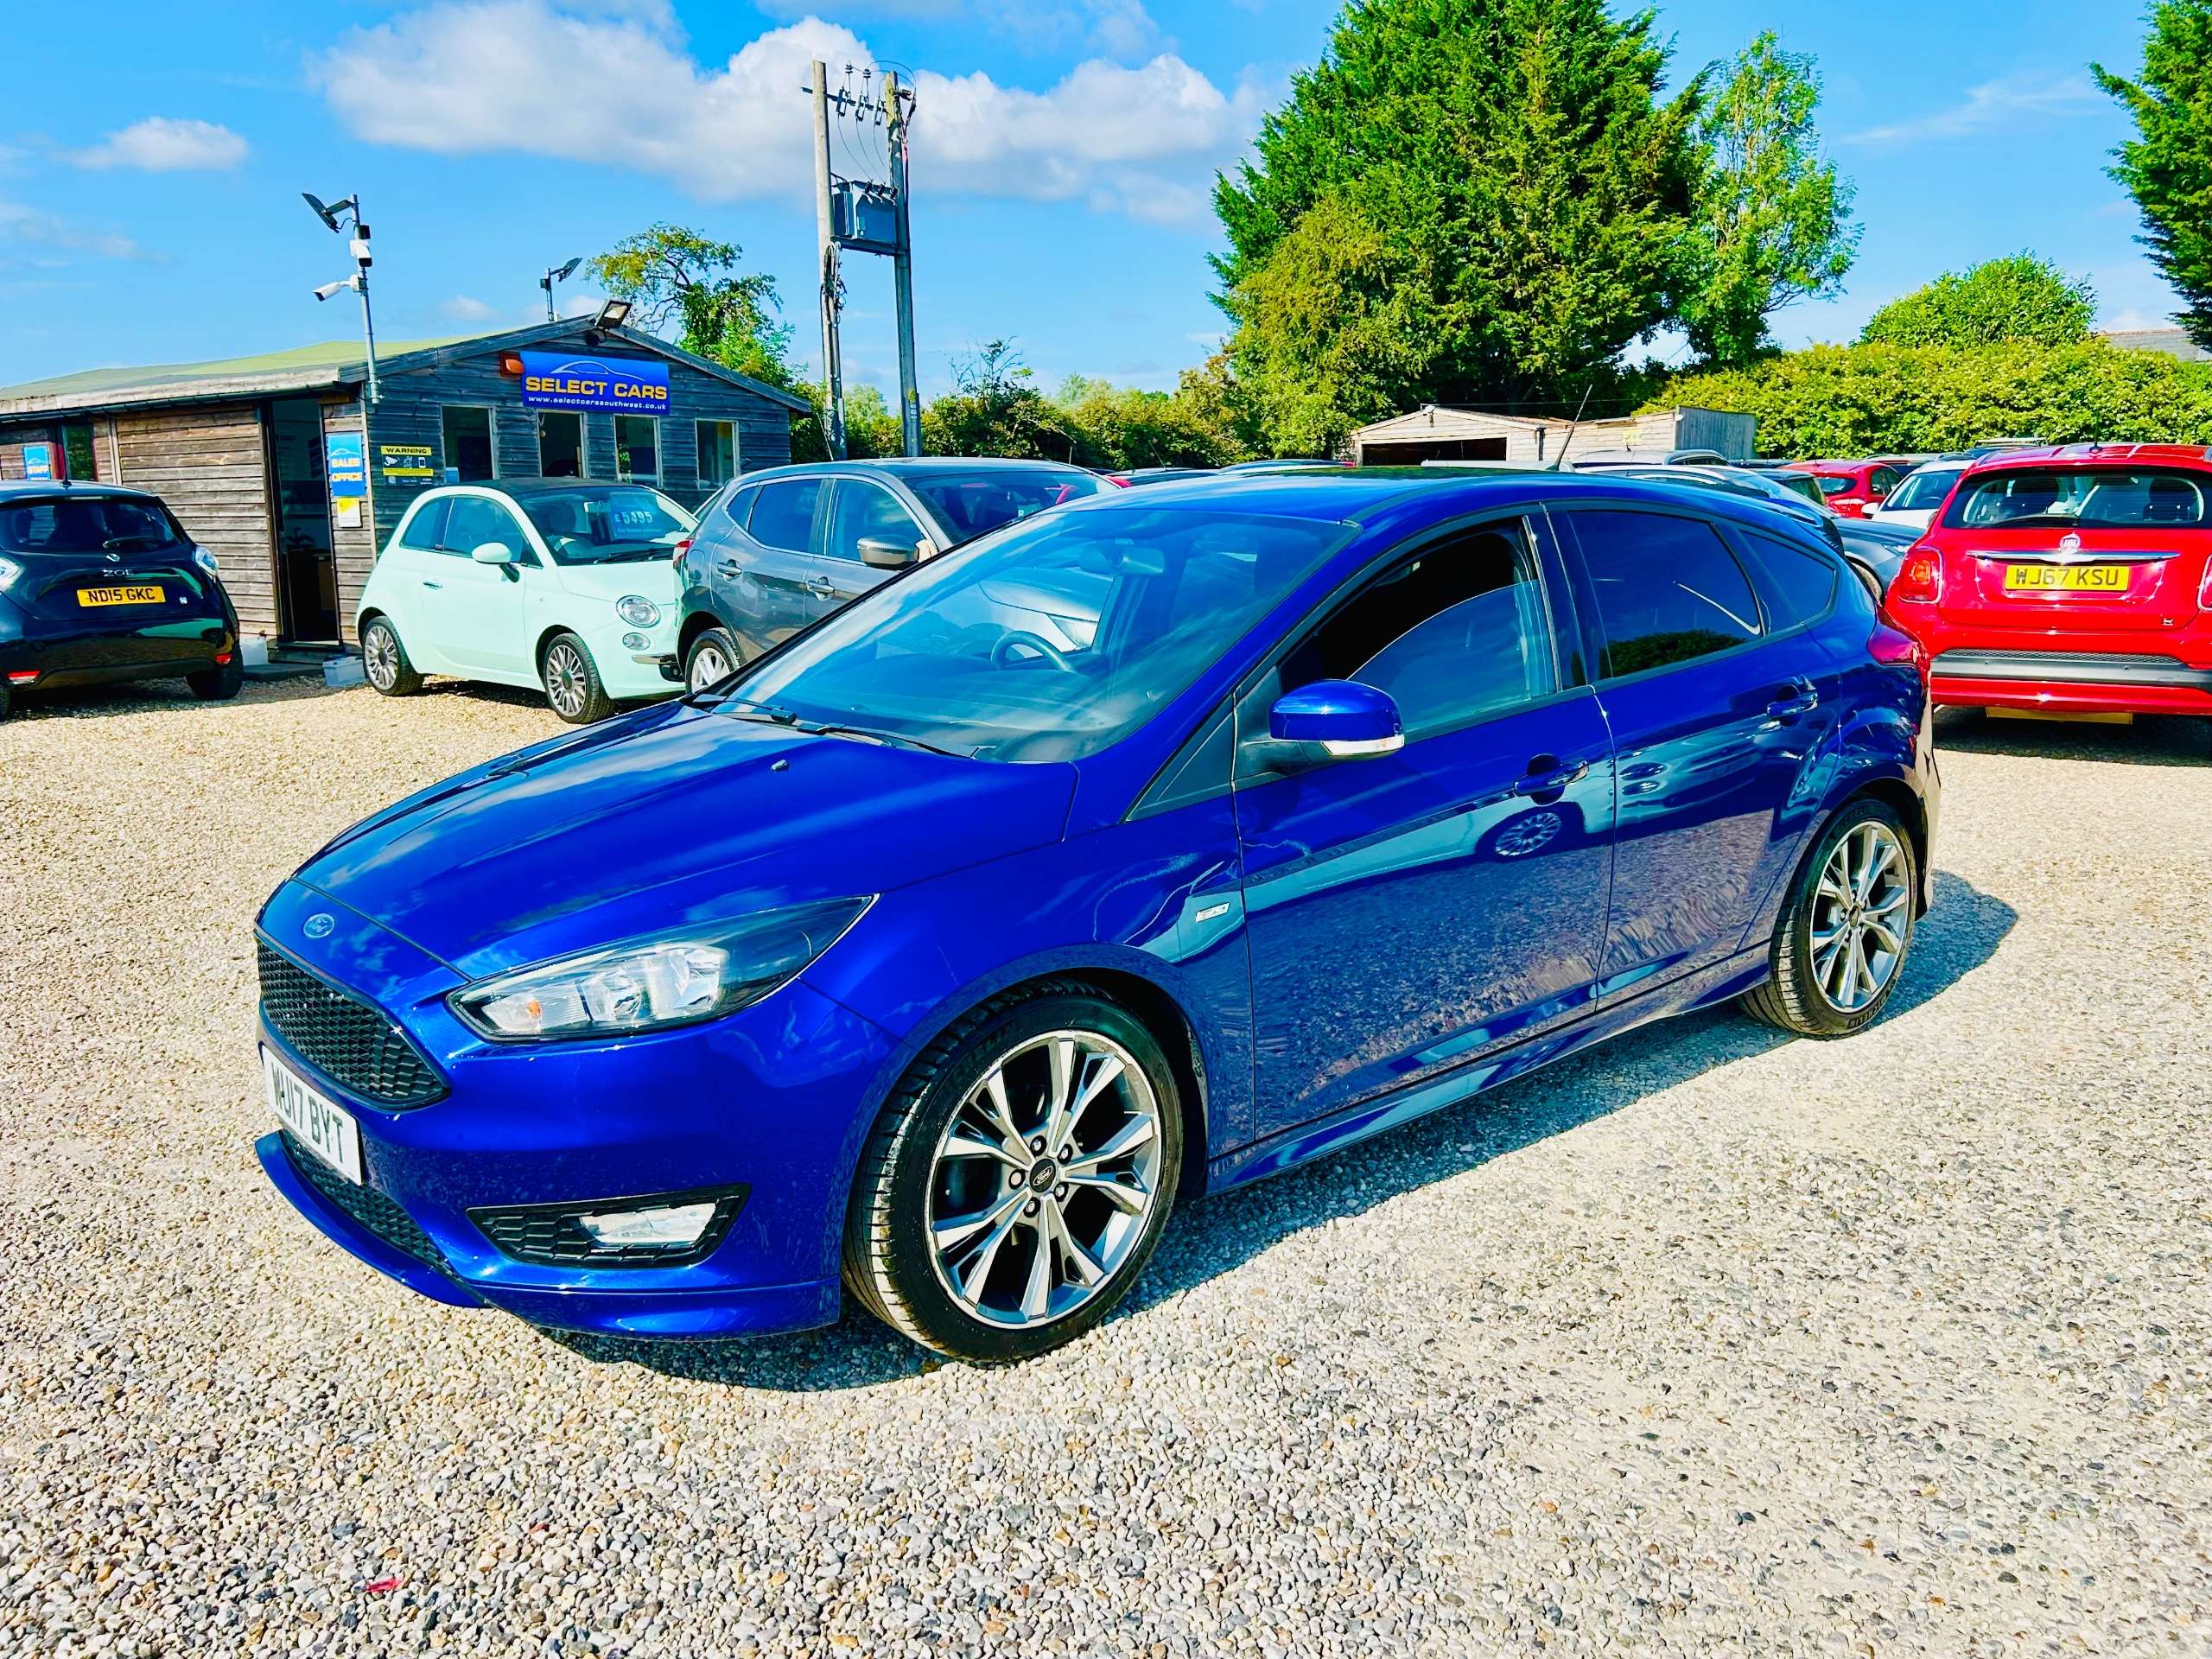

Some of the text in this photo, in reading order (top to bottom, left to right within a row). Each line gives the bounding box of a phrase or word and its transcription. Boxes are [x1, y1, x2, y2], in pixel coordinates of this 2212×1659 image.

[525, 377, 667, 400] SELECT CARS
[528, 396, 666, 410] www.selectcarssouthwest.co.uk
[331, 458, 360, 467] SALES
[332, 473, 363, 482] OFFICE
[2015, 568, 2118, 586] WJ67 KSU
[87, 588, 156, 603] ND15 GKC
[308, 1095, 343, 1163] BYT
